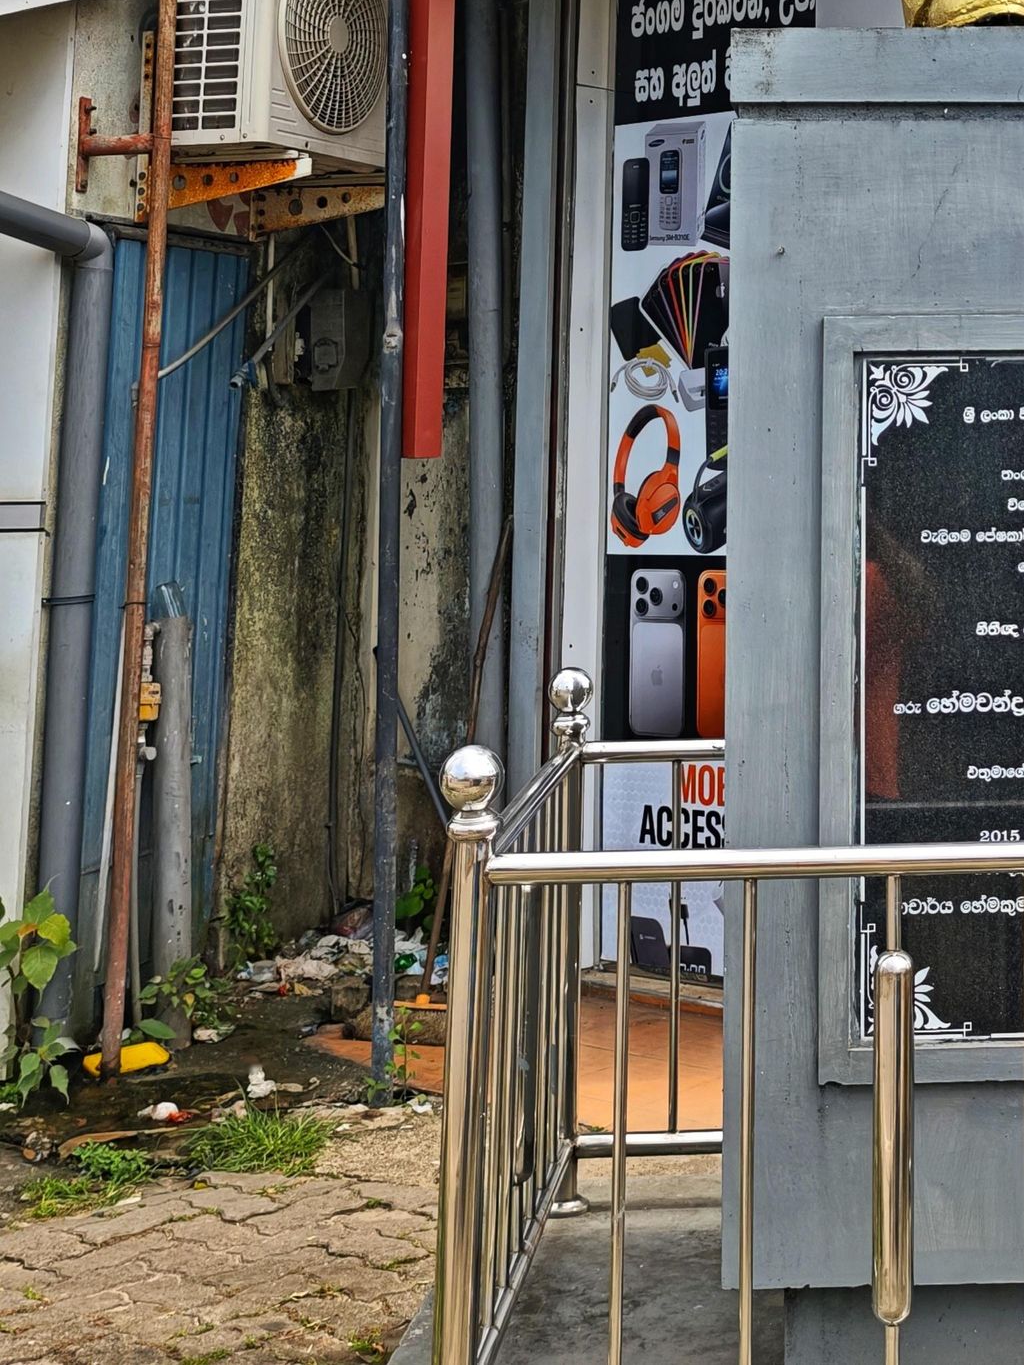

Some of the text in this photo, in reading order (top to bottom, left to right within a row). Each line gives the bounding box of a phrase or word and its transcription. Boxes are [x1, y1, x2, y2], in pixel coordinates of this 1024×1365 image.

[634, 65, 665, 103] සහ
[671, 49, 717, 108] අලුත්
[980, 409, 1015, 423] ලංකා
[920, 529, 971, 544] වැලිගම
[893, 701, 922, 715] ගරු
[979, 830, 1021, 842] 2015
